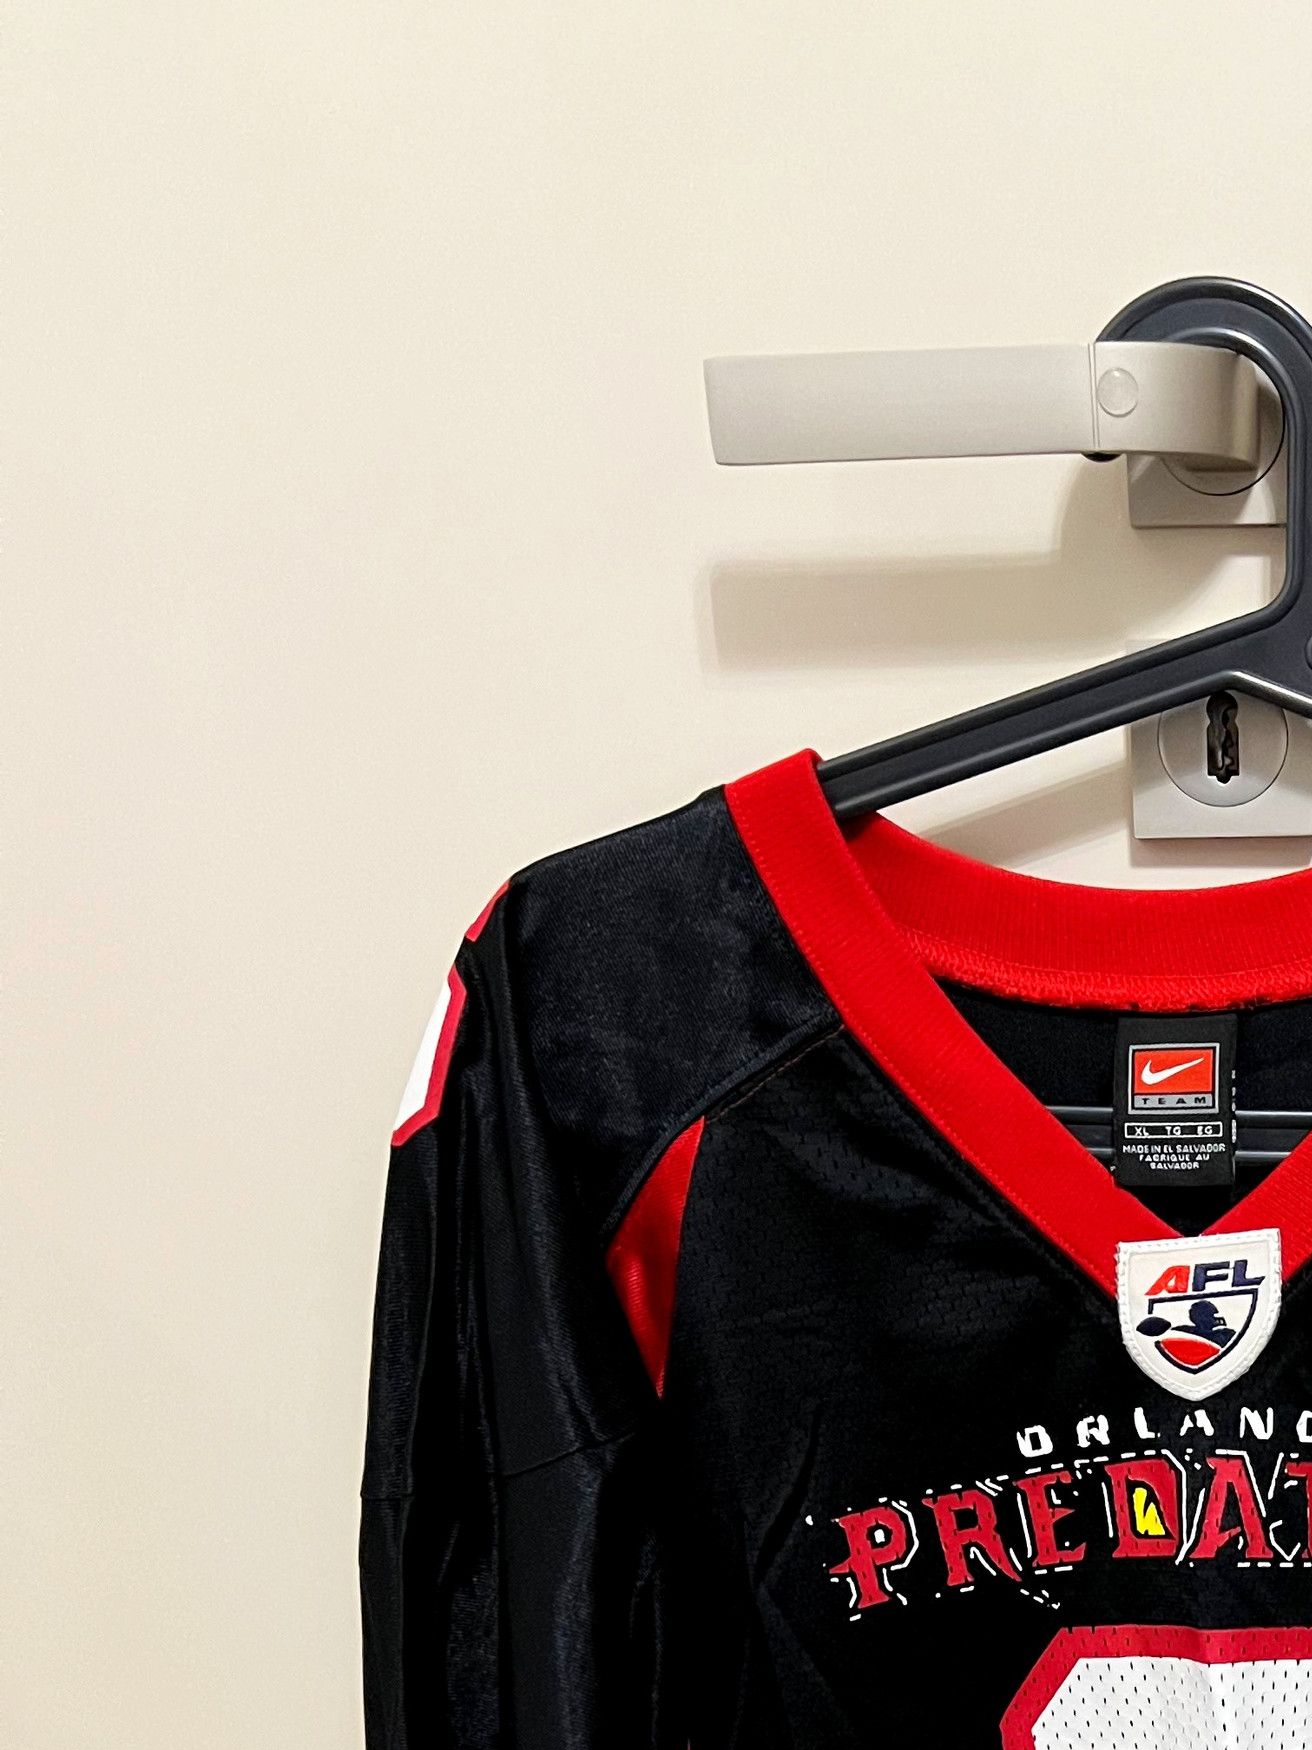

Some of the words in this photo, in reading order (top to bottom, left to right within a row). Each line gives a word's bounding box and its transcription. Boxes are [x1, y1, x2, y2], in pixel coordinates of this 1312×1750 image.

[1141, 1096, 1207, 1105] TEAM
[1134, 1126, 1150, 1136] XL
[1165, 1126, 1181, 1136] TG
[1197, 1125, 1213, 1136] EG
[1122, 1144, 1149, 1154] MADE
[1150, 1144, 1161, 1154] IN
[1163, 1144, 1174, 1154] EL
[1176, 1143, 1226, 1154] SALVADOR
[1195, 1153, 1210, 1162] AU
[1149, 1161, 1200, 1170] SALVADOR
[1144, 1259, 1266, 1296] AFL
